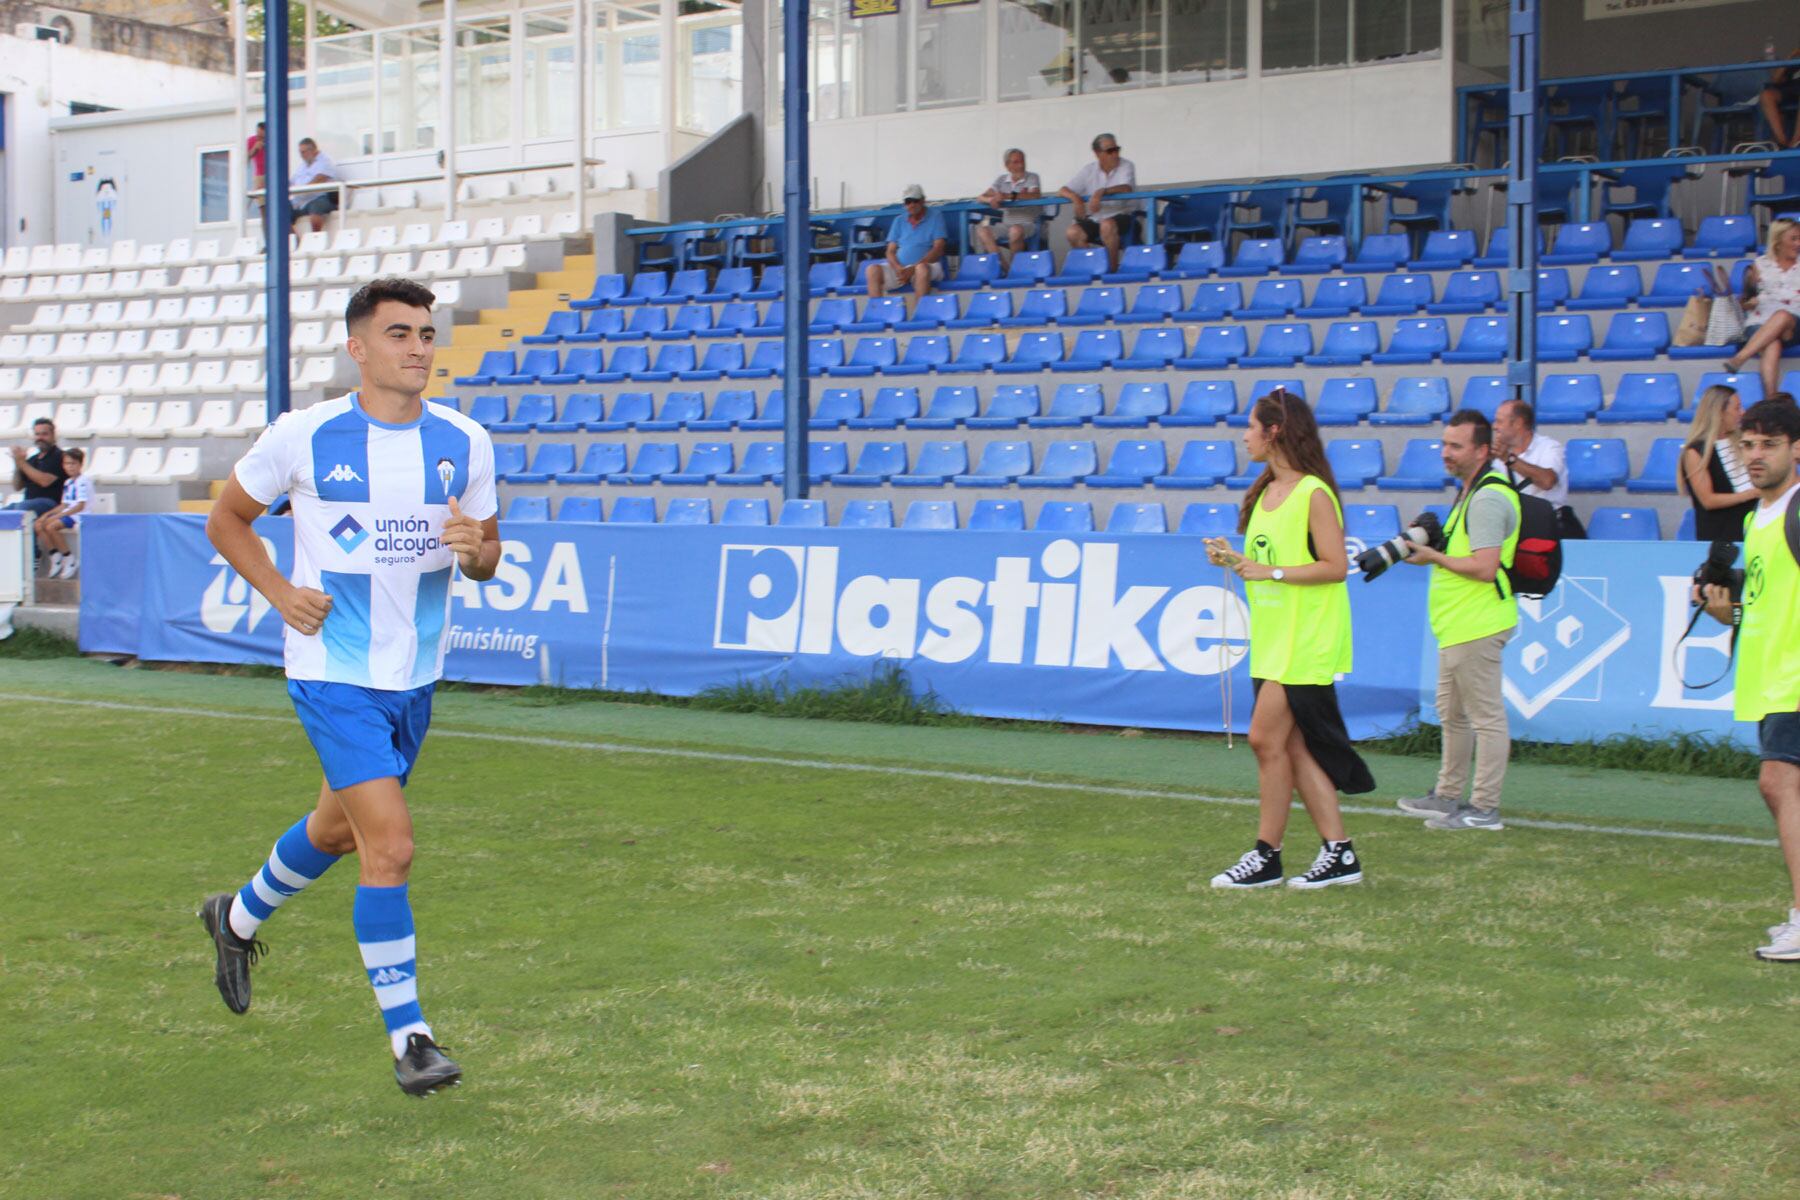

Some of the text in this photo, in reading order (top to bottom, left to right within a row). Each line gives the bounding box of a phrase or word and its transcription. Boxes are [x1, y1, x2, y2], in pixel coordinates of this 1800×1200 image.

[375, 515, 429, 532] unión
[374, 556, 416, 566] seguros
[713, 539, 1251, 675] plastike
